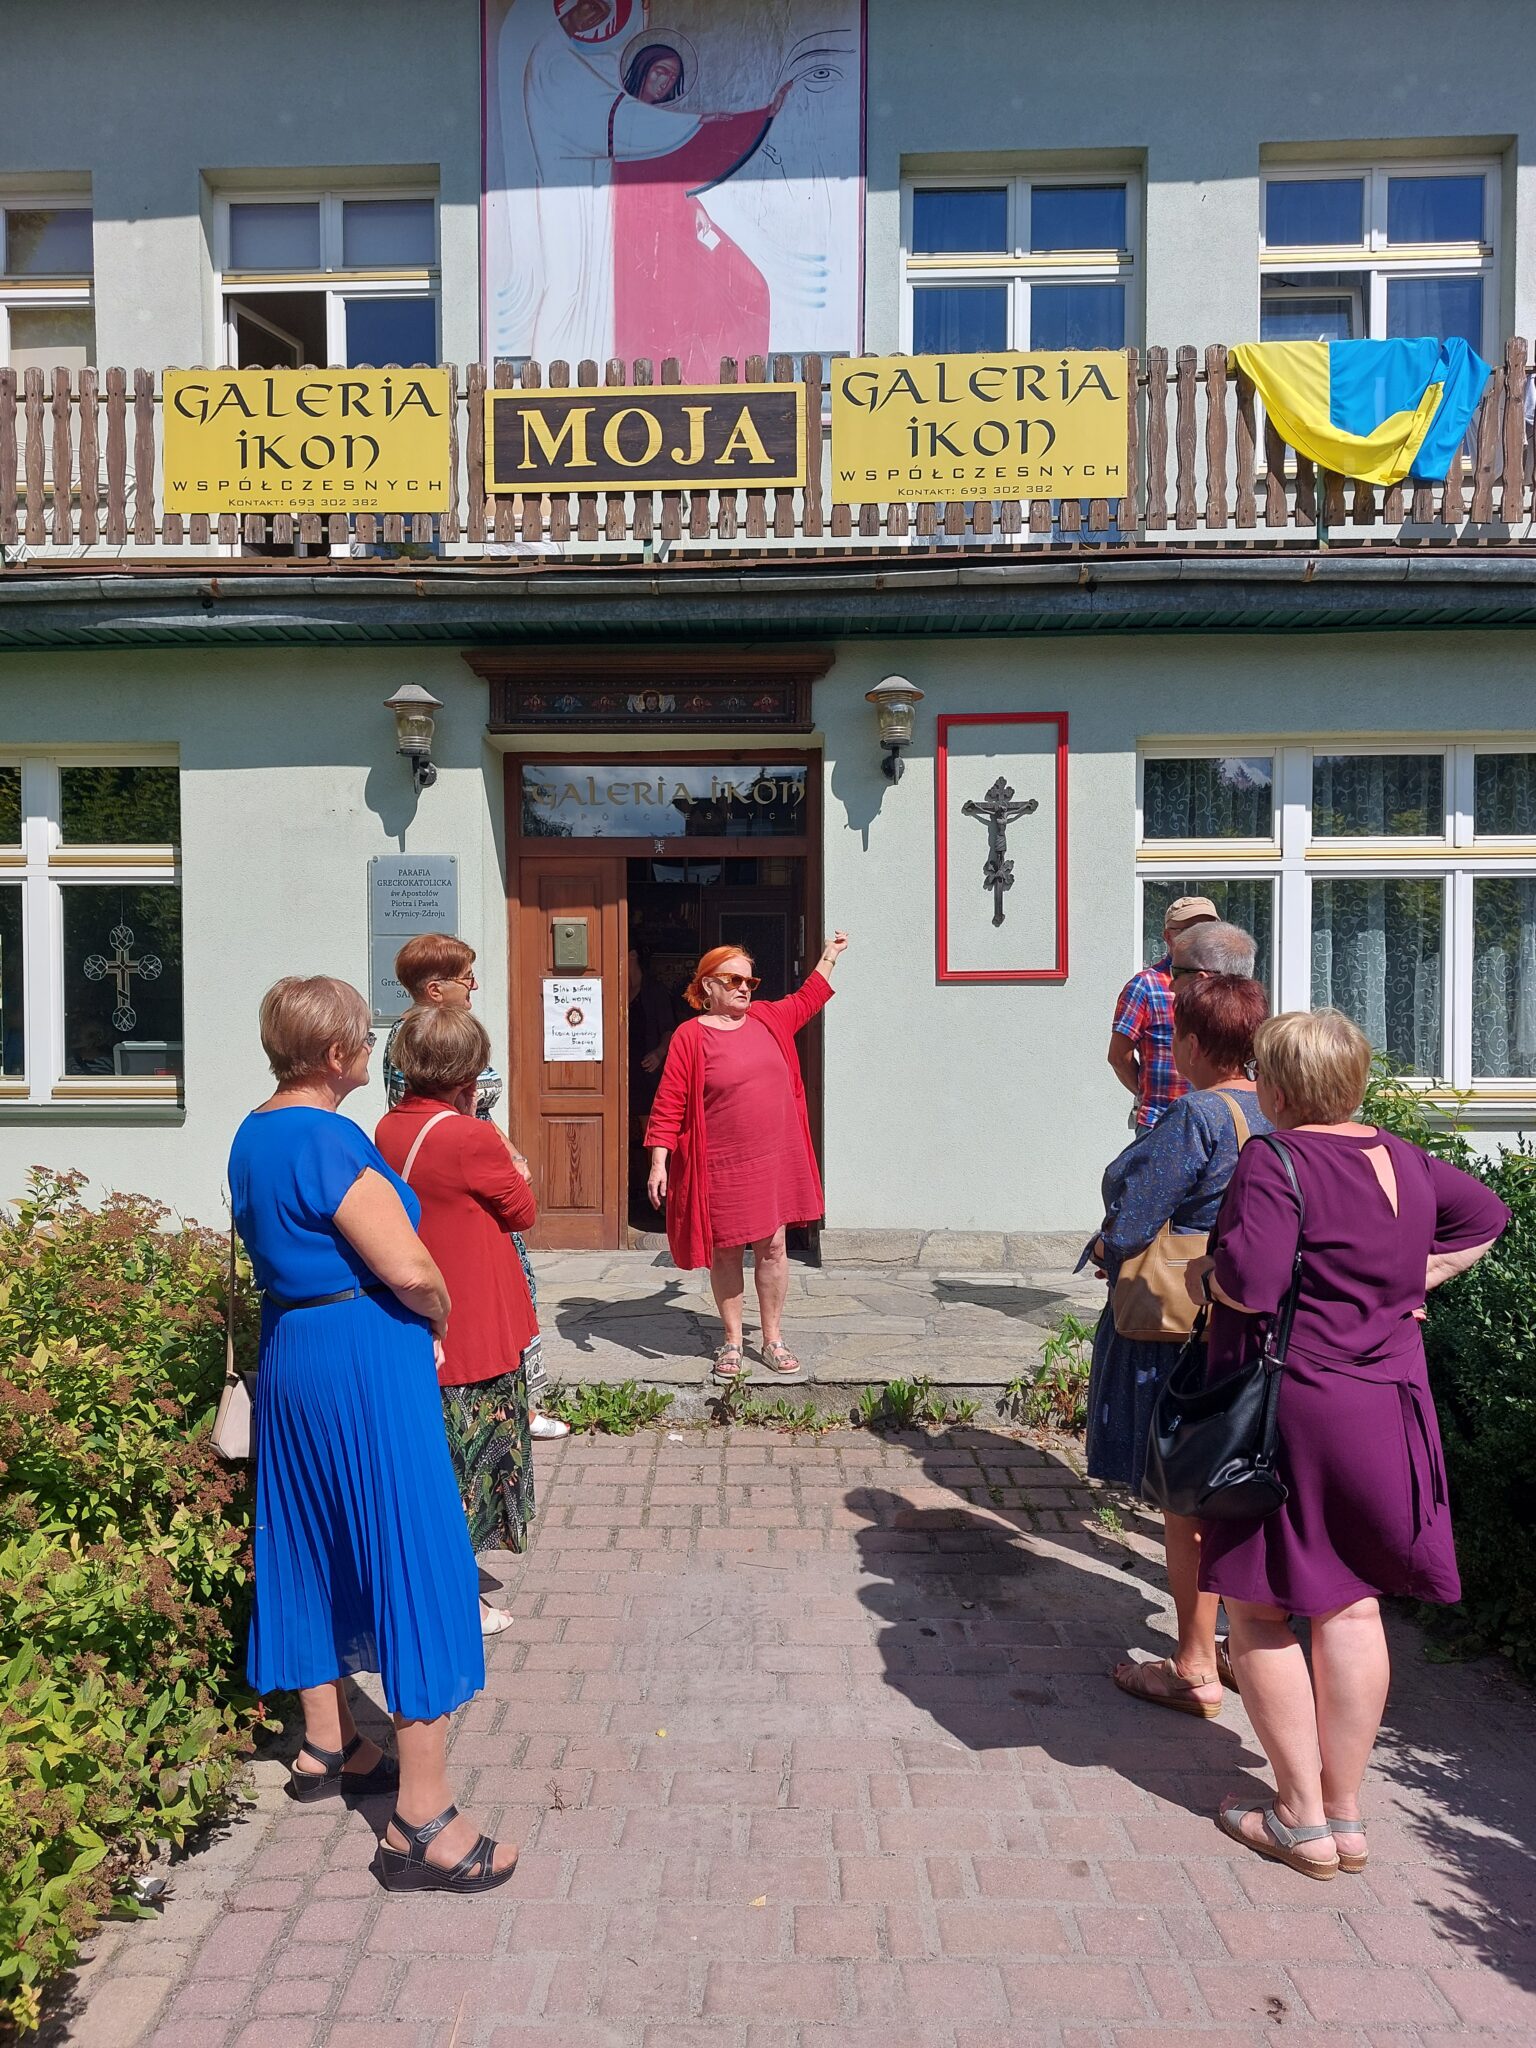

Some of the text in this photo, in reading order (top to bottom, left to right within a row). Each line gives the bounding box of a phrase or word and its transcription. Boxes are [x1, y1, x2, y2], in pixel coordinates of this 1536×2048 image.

[516, 405, 776, 469] MOJA
[840, 464, 1119, 481] WSPÓŁCZESNYCH
[173, 477, 442, 491] WSPÓŁCZESNYCH
[960, 486, 987, 495] 693
[993, 486, 1020, 494] 302
[1026, 484, 1054, 493] 382
[398, 868, 431, 876] PARAFIA
[377, 879, 452, 887] GRECKOKATOLICKA
[401, 890, 439, 898] Apostołów
[392, 909, 446, 919] Krynicy-Zdroju
